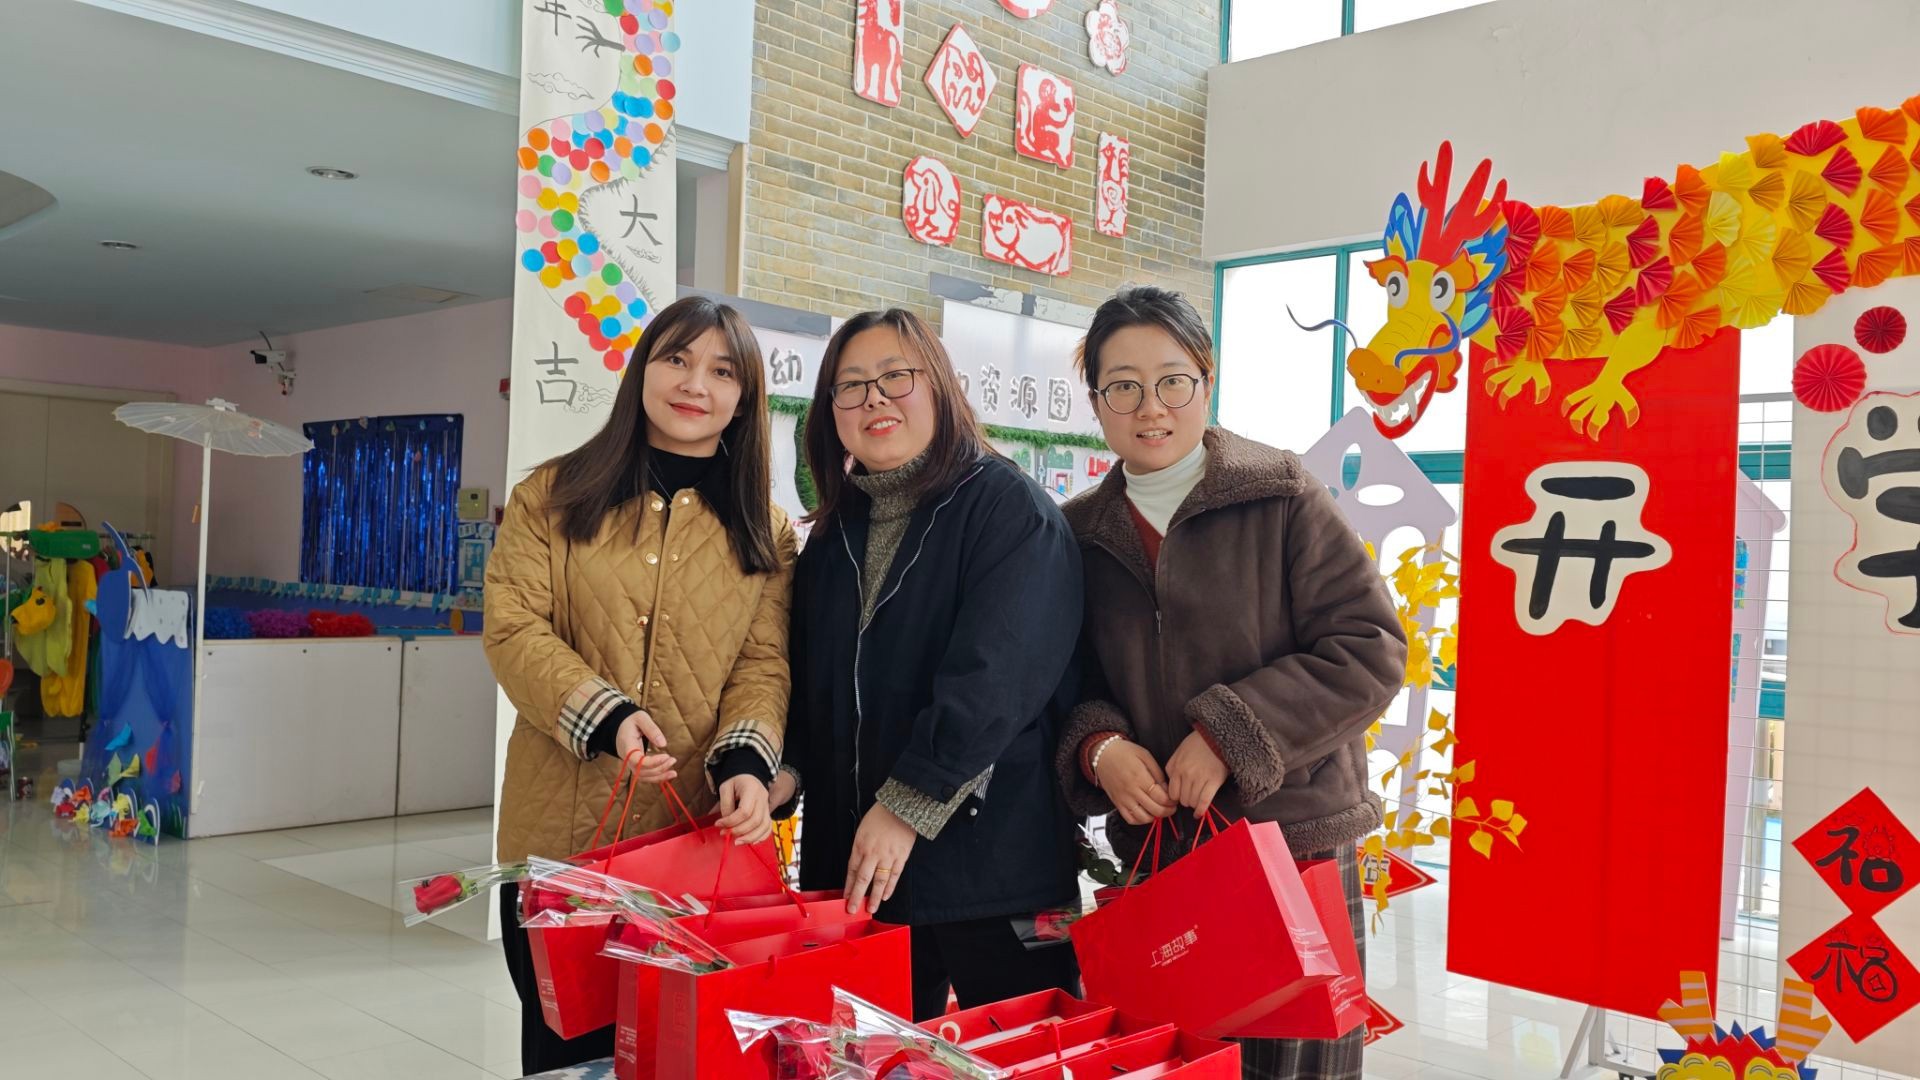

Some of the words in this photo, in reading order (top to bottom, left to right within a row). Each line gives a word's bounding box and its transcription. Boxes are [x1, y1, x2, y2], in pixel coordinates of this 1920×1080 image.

[619, 194, 663, 246] 大
[534, 341, 579, 406] 吉
[770, 347, 802, 384] 幼
[1501, 476, 1656, 620] 开
[1150, 929, 1198, 968] 上海故事
